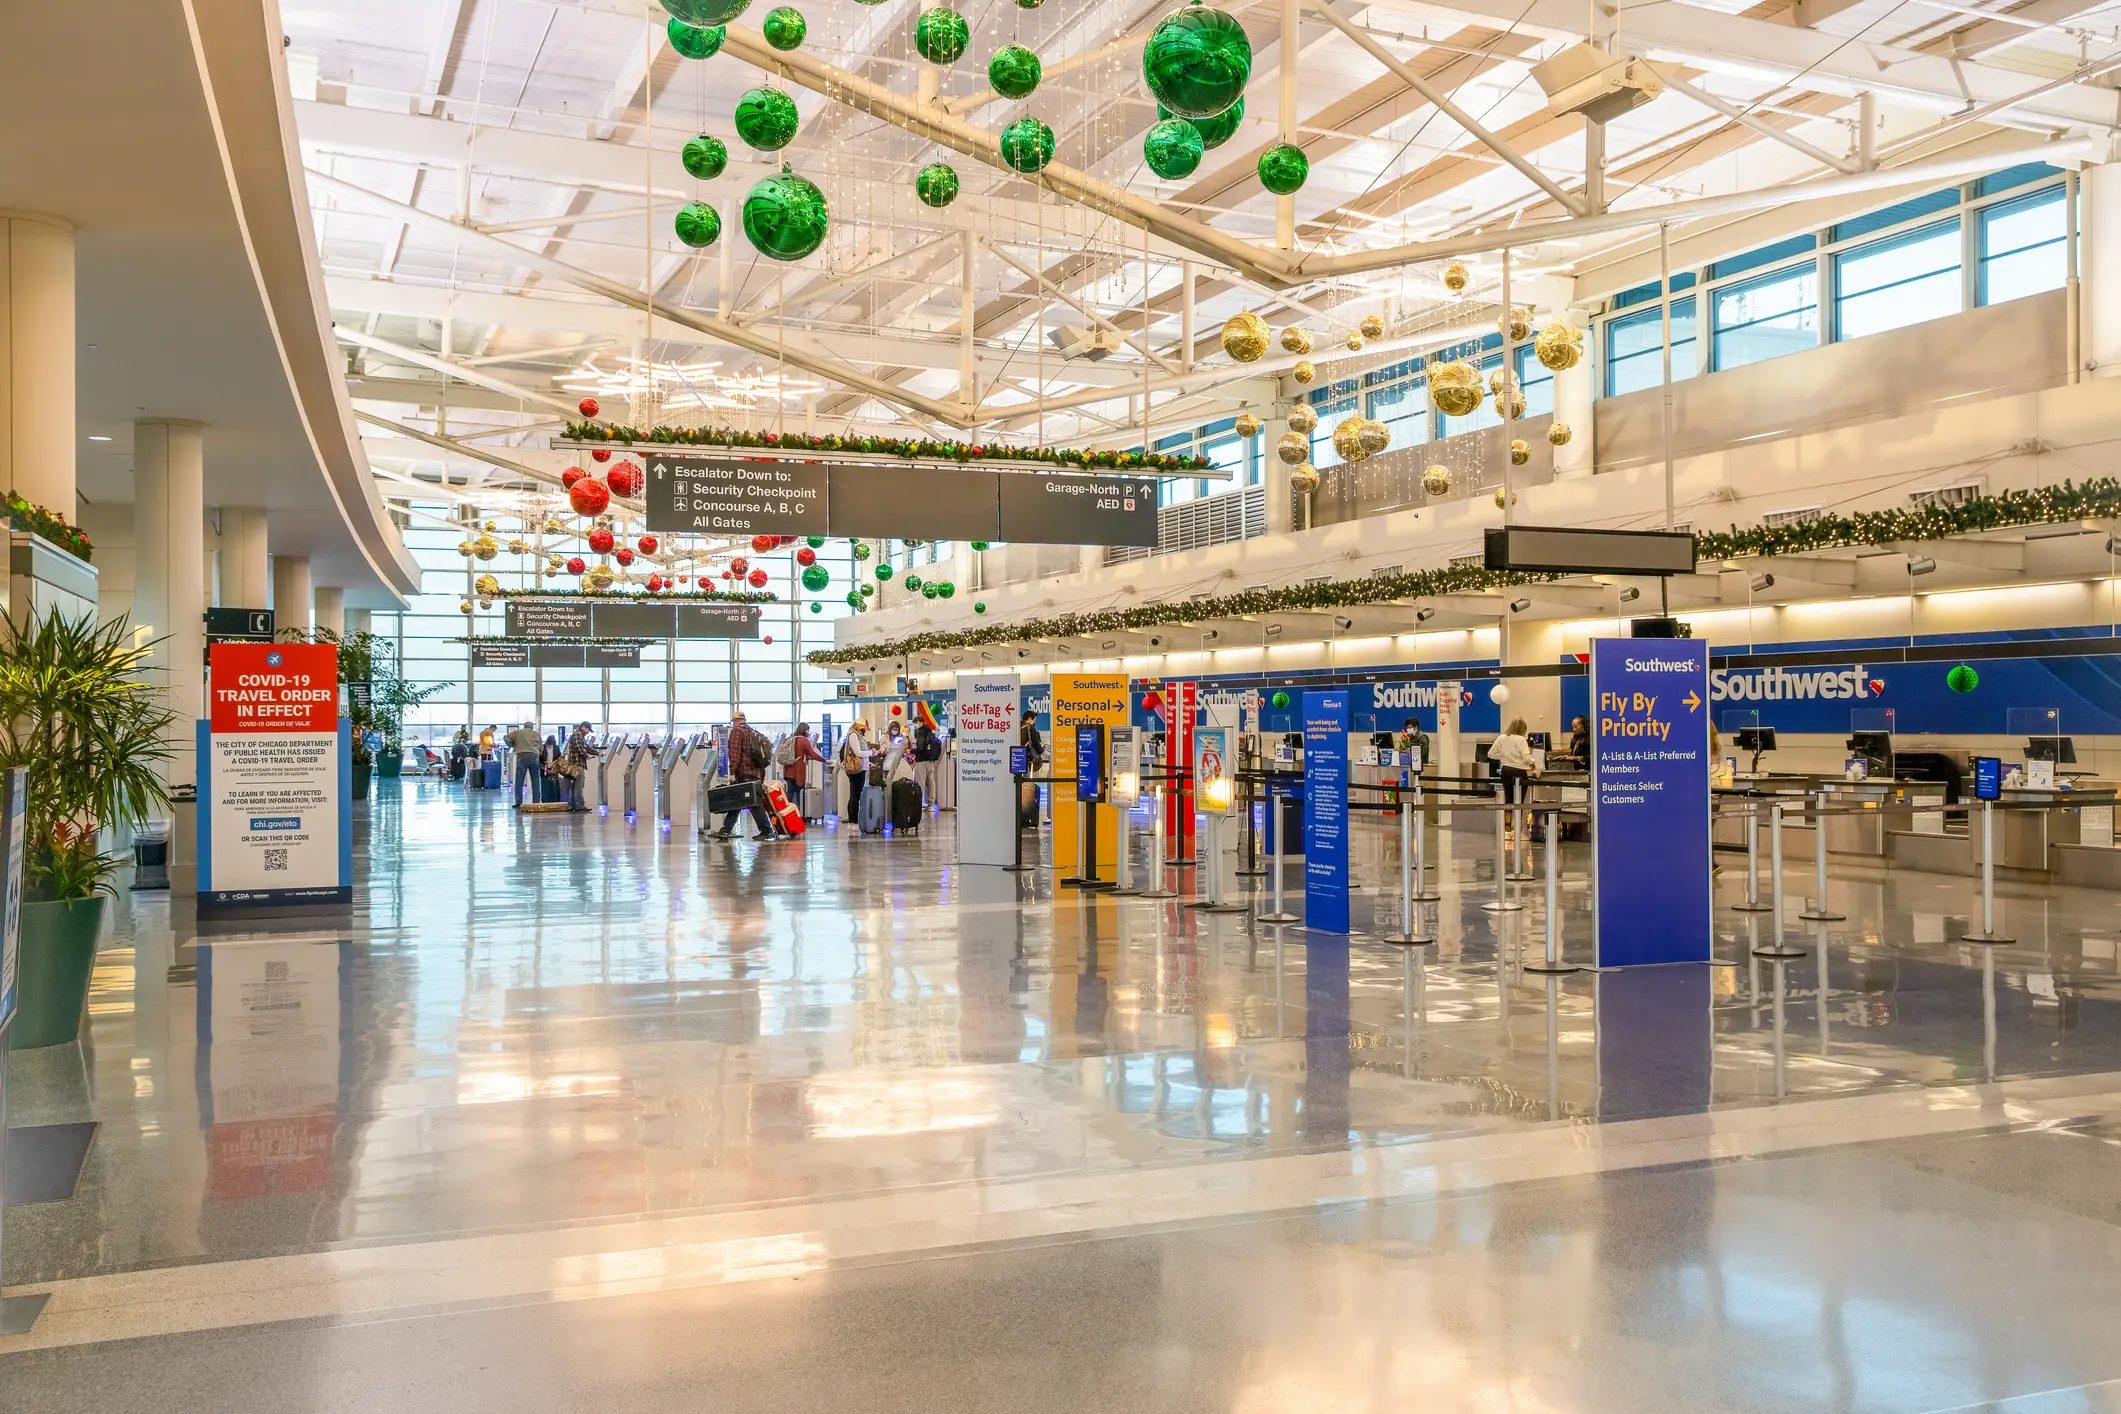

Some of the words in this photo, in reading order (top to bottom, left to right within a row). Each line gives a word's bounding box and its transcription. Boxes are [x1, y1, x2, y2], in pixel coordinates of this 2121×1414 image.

[675, 466, 733, 479] Escalator
[737, 469, 771, 481] Down
[775, 471, 791, 481] to:
[693, 483, 743, 497] Security
[747, 486, 816, 499] Checkpoint
[1046, 482, 1119, 495] Garage-North
[693, 500, 760, 512] Concourse
[764, 503, 776, 514] A,
[780, 503, 792, 515] B,
[796, 504, 804, 513] C
[1097, 499, 1119, 509] AED
[693, 516, 709, 527] All
[713, 517, 750, 528] Gates
[1626, 658, 1694, 672] Southwest
[239, 675, 310, 686] COVID-19
[1711, 665, 1868, 701] Southwest
[975, 684, 1010, 692] Southwest
[217, 690, 277, 701] TRAVEL
[281, 690, 331, 701] ORDER
[1196, 689, 1249, 710] Southwe
[1028, 696, 1050, 713] South
[1057, 699, 1110, 710] Personal
[1601, 692, 1627, 716] Fly
[1633, 693, 1655, 716] By
[238, 705, 253, 716] IN
[258, 705, 312, 716] EFFECT
[962, 704, 1000, 717] Self-Tag
[962, 719, 984, 729] Your
[988, 719, 1010, 732] Bags
[1056, 715, 1103, 726] Service
[1601, 718, 1670, 741] Priority
[1601, 752, 1624, 761] A-List
[1626, 752, 1632, 760] &
[1634, 751, 1657, 760] A-List
[1660, 750, 1696, 759] Preferred
[1602, 765, 1639, 773] Members
[1602, 783, 1636, 791] Business
[1602, 795, 1644, 804] Customers
[254, 820, 297, 829] chi.gov/eto
